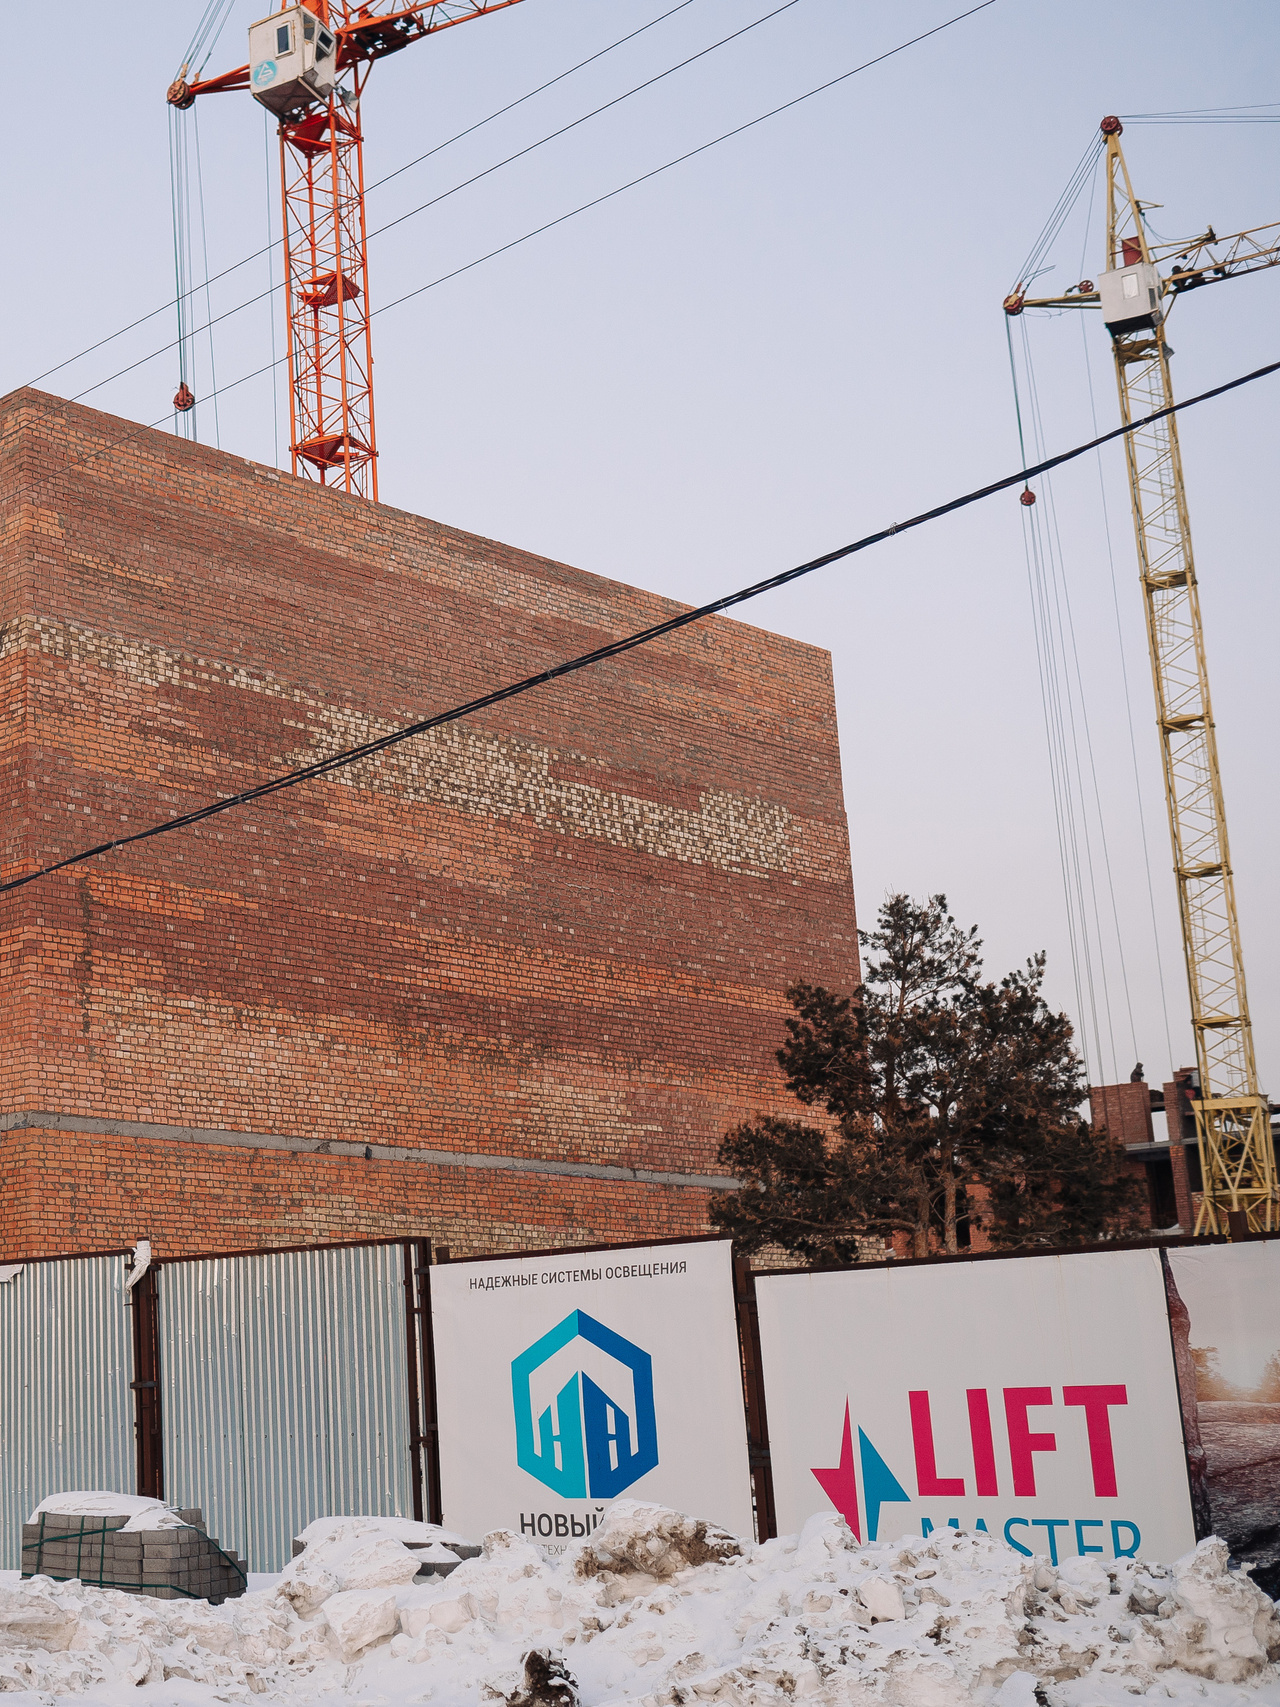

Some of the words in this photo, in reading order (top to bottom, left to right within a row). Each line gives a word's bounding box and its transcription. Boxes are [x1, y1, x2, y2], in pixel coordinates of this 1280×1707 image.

[469, 1273, 538, 1291] НАДЕЖНЫЕ
[540, 1267, 602, 1285] СИСТЕМЫ
[605, 1260, 687, 1279] ОСВЕЩЕНИЯ
[908, 1384, 1128, 1498] LIFT
[921, 1517, 1141, 1567] STER
